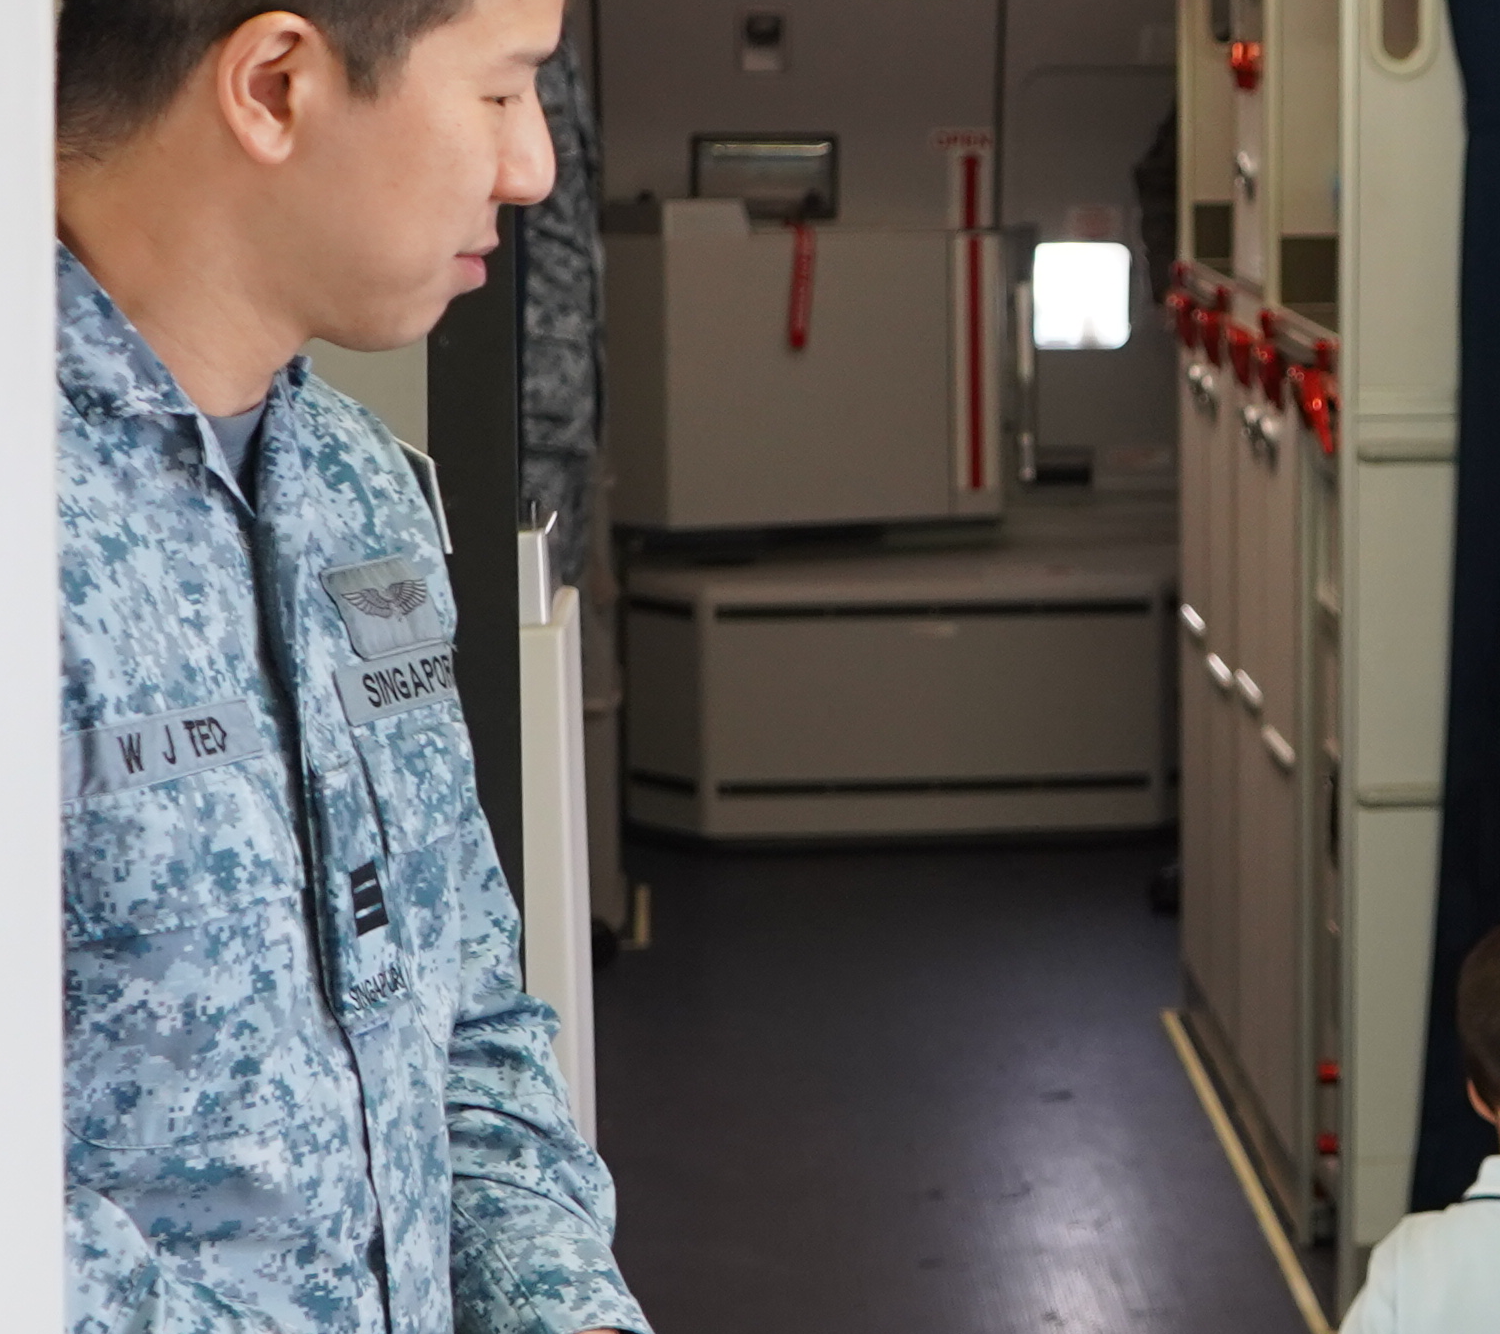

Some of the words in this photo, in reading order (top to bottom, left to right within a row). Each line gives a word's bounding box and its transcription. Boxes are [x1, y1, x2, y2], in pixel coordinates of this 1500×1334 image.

[116, 732, 145, 774] W
[162, 724, 177, 765] J
[181, 716, 228, 758] TEO
